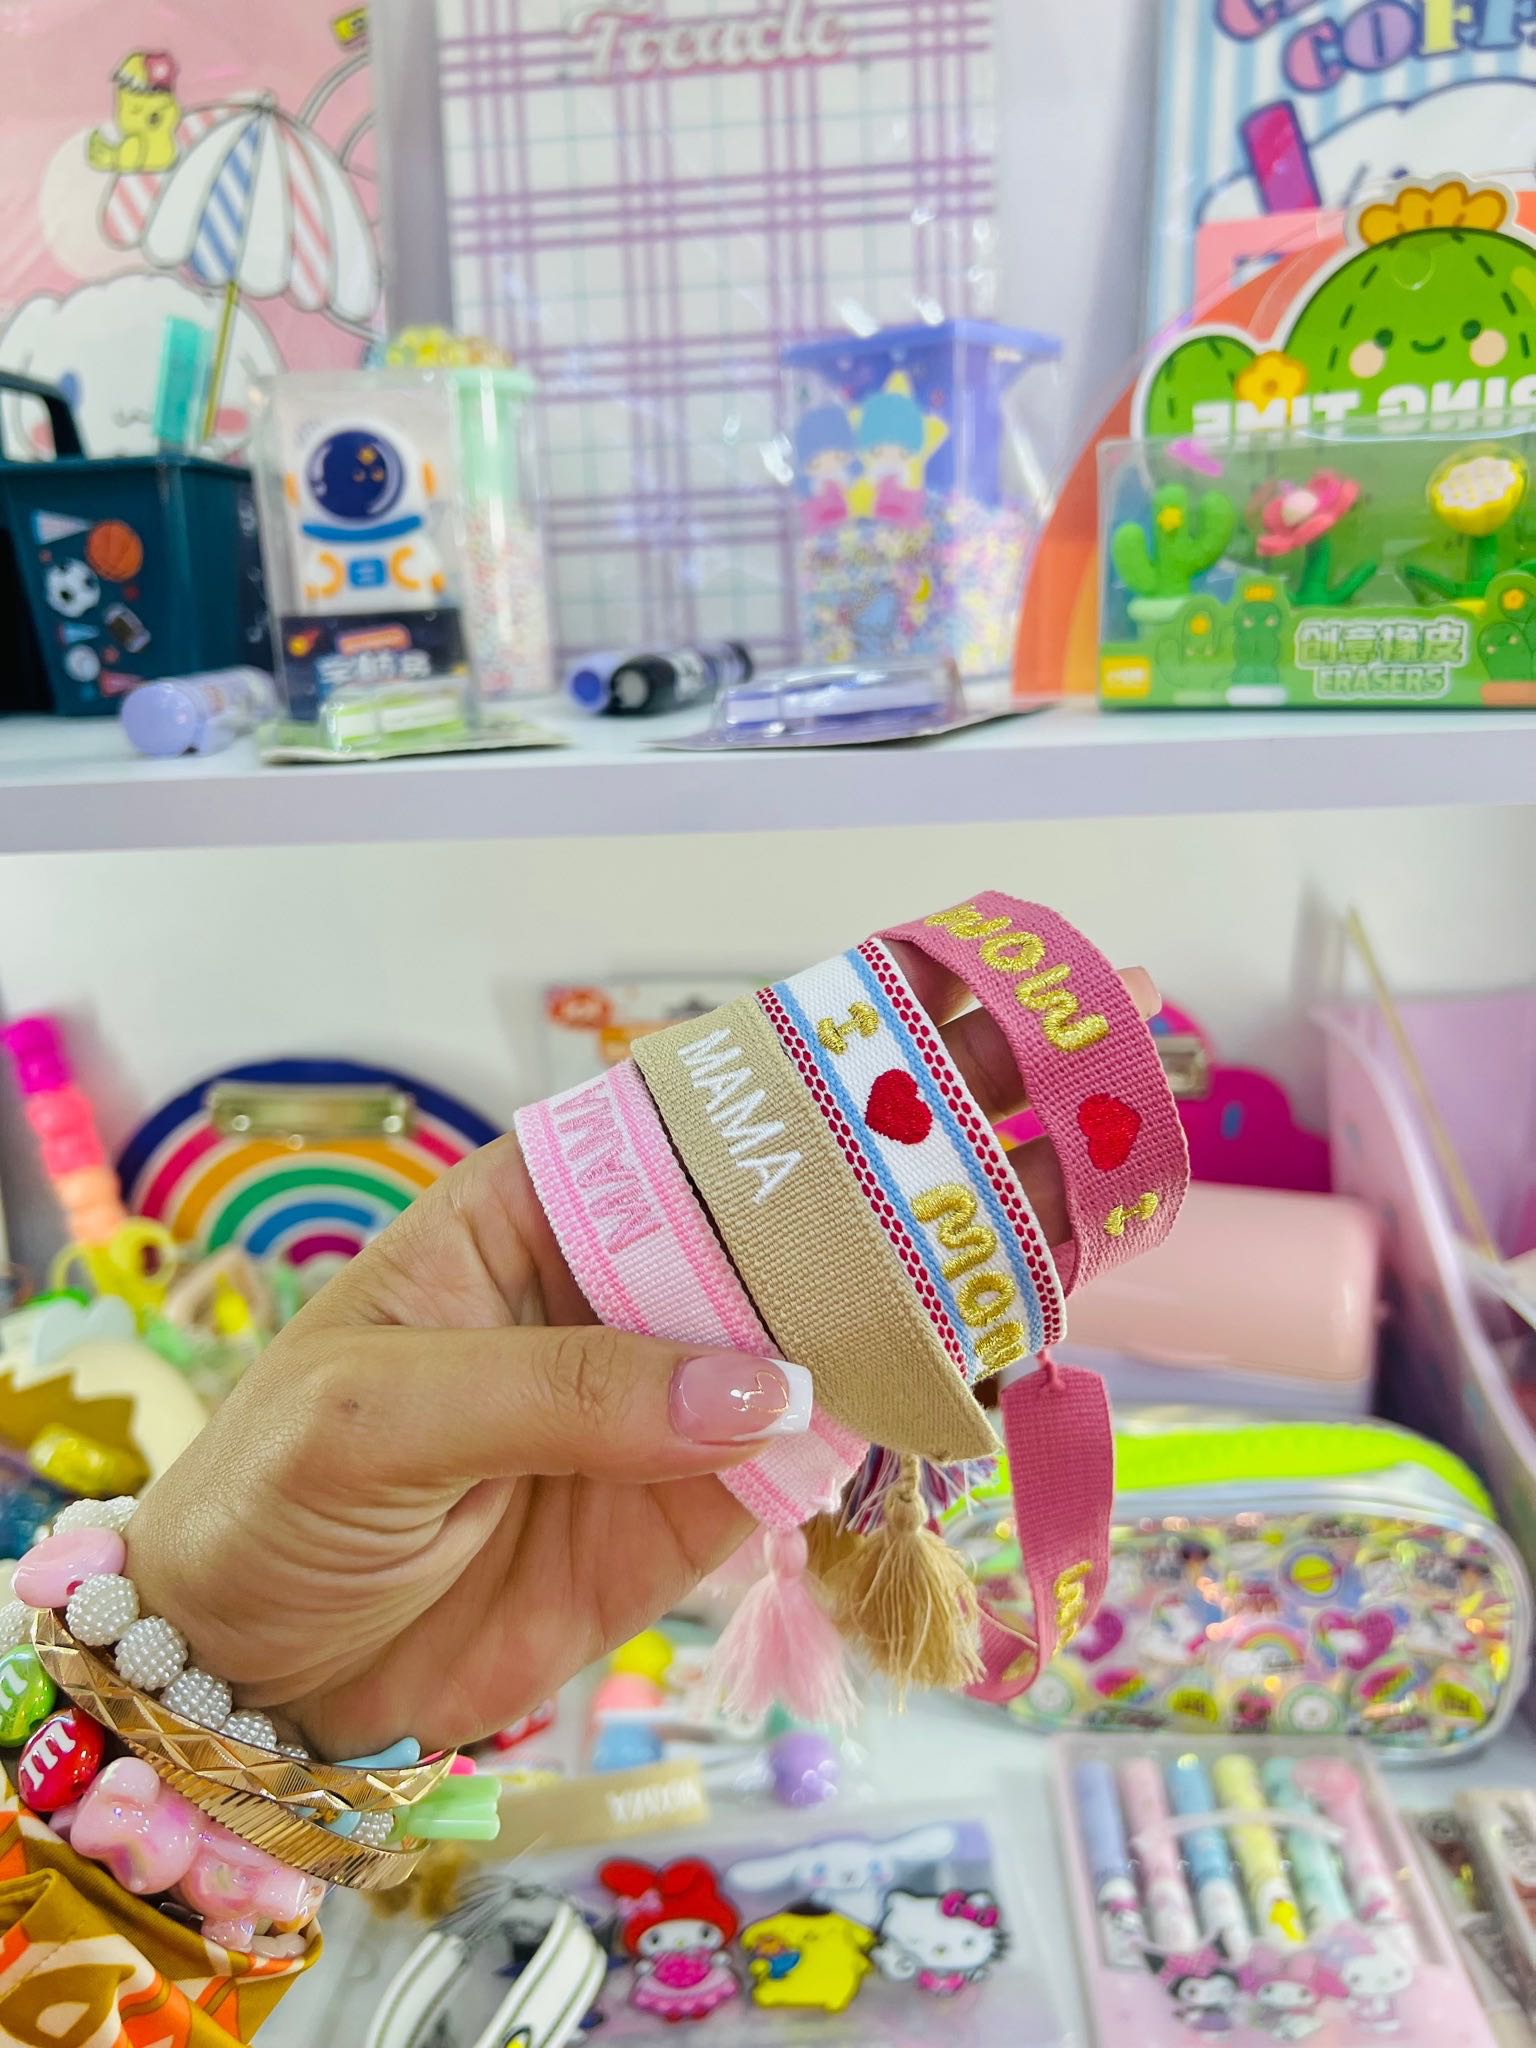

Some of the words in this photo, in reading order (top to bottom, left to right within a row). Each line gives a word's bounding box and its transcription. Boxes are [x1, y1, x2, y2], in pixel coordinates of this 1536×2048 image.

[1318, 667, 1446, 693] ERASERS
[817, 1001, 879, 1056] I
[923, 901, 1110, 1052] MOM
[553, 1080, 663, 1255] MAMA
[677, 1027, 801, 1206] MAMA
